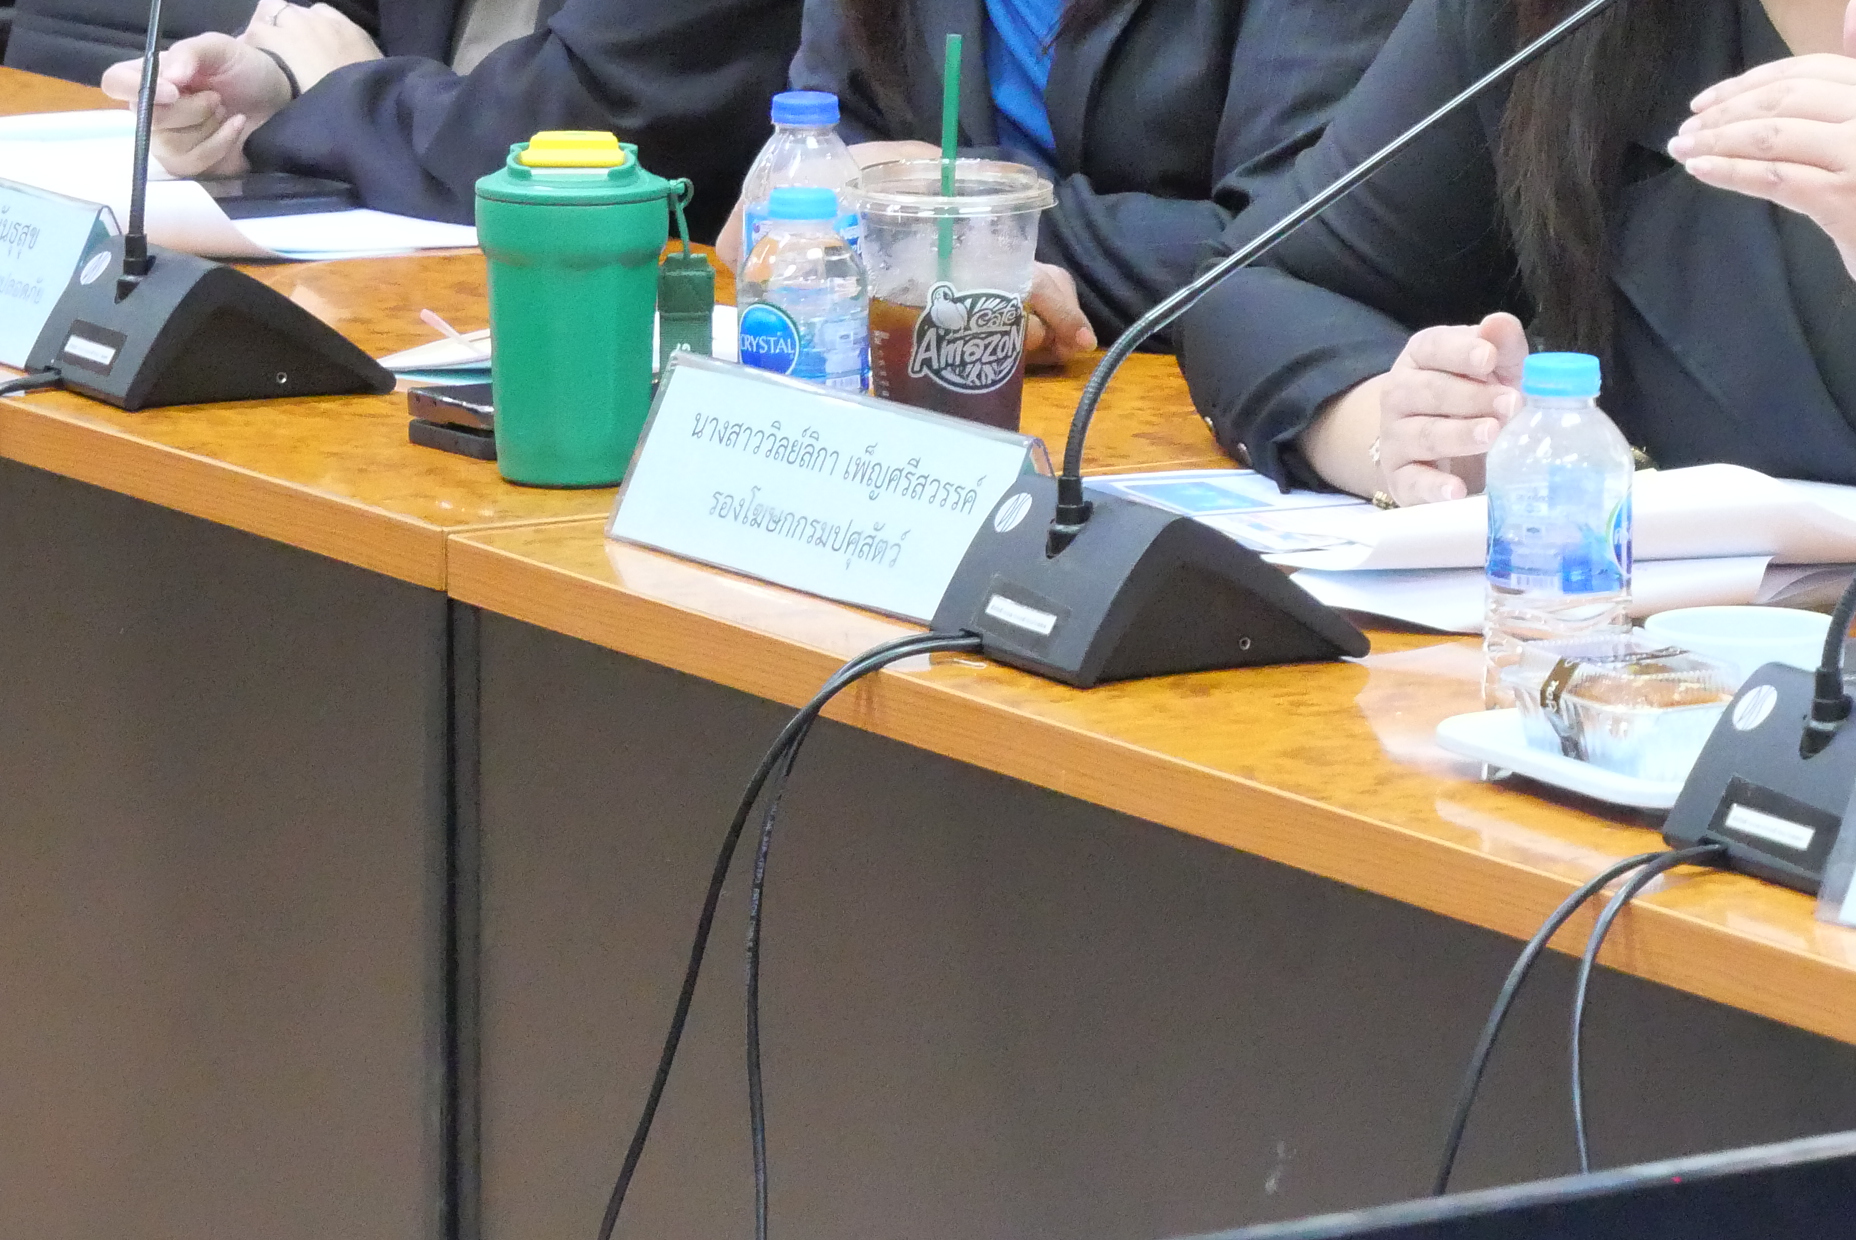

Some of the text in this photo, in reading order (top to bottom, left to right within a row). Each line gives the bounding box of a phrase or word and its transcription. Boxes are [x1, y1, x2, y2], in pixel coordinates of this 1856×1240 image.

[690, 412, 988, 516] นางสาววิลย์ลิกา เพ็ญศรีสวรรค์
[708, 485, 912, 571] รองโฆษกกรมปศุสัตว์
